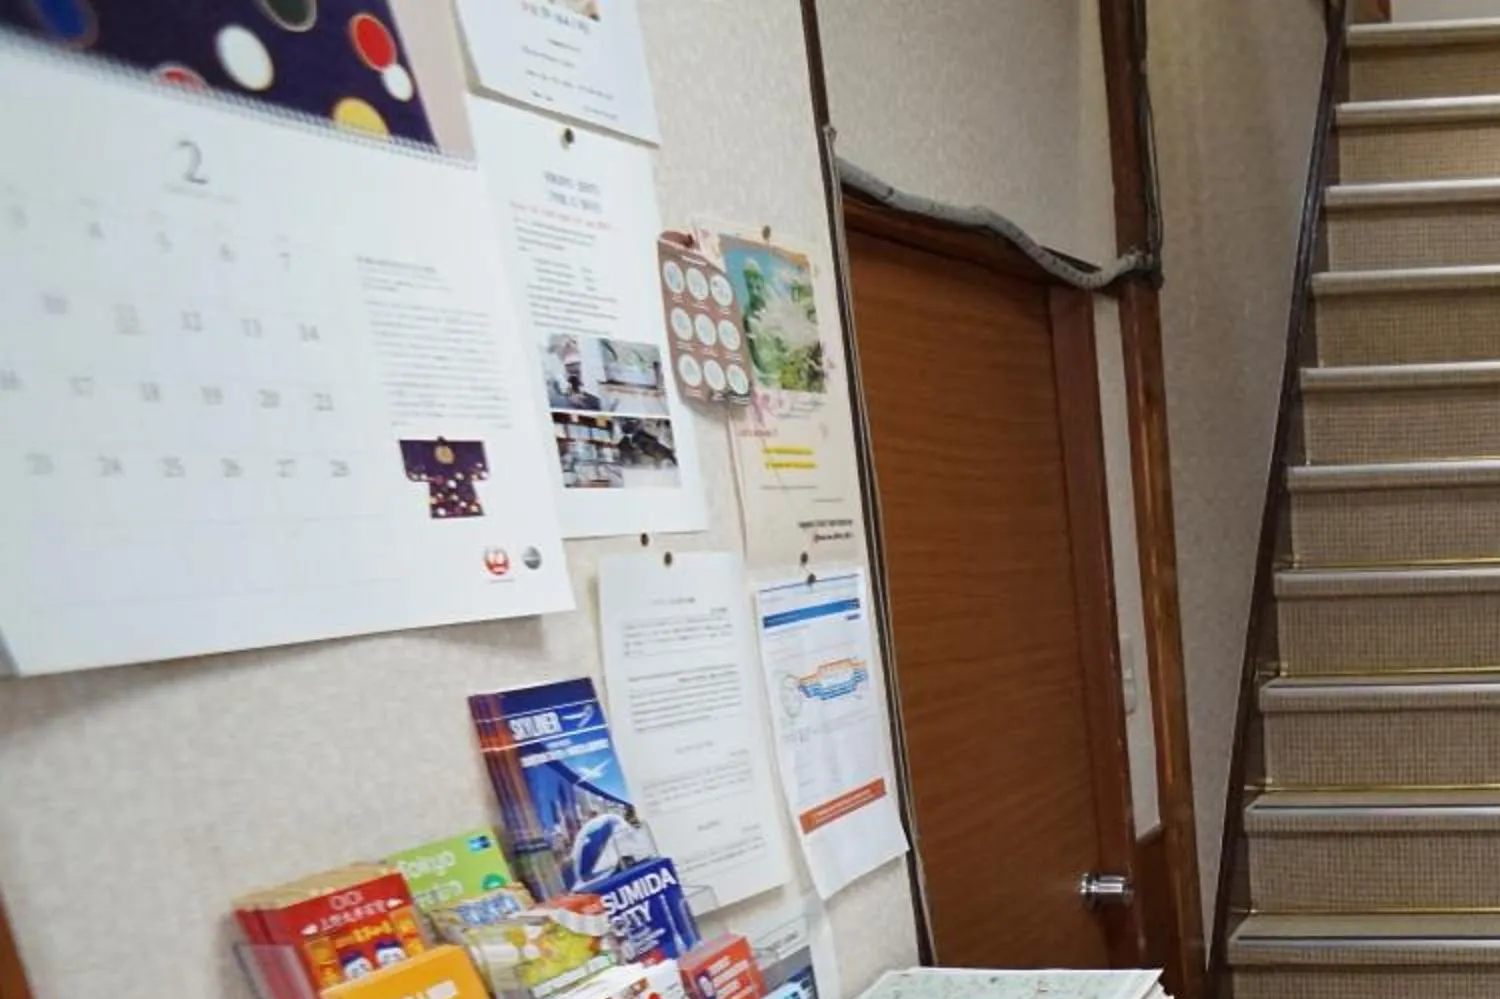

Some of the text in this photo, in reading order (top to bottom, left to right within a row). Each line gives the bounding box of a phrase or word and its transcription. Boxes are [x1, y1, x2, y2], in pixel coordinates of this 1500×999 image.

[177, 139, 208, 184] 2
[601, 868, 676, 914] SUMIDA
[606, 902, 654, 940] CITY
